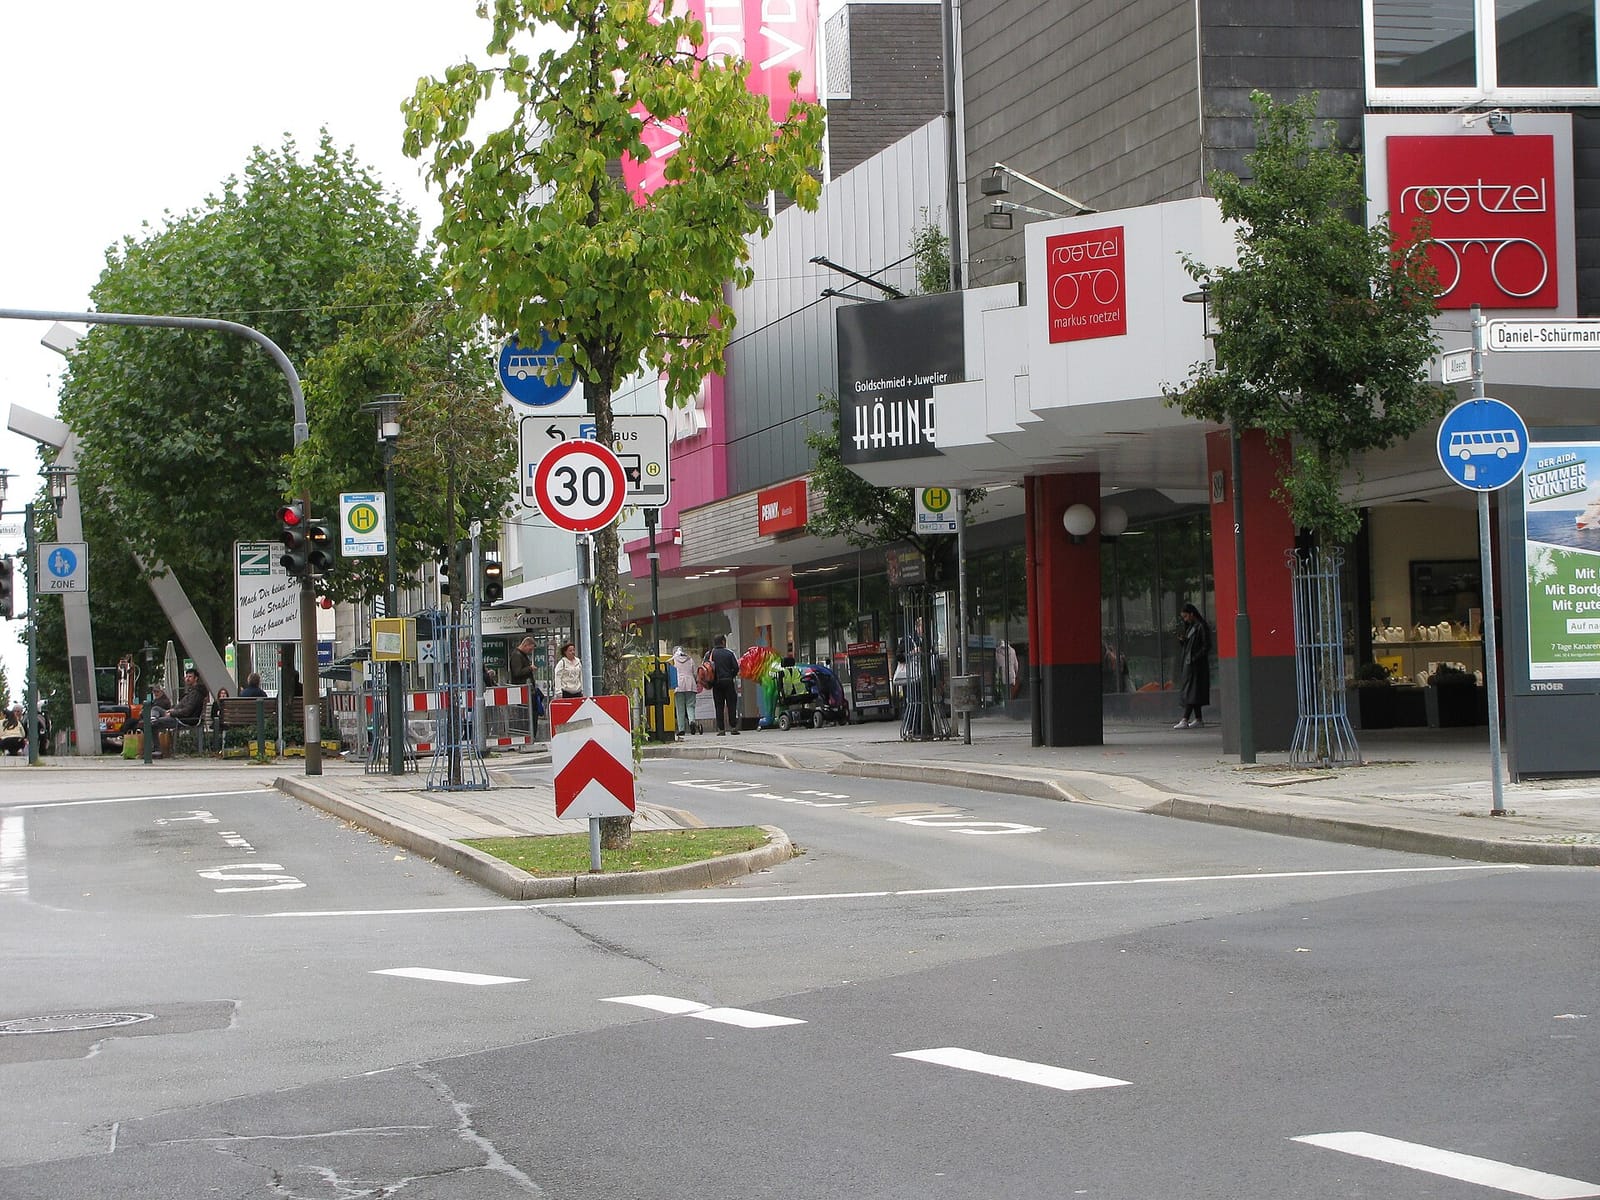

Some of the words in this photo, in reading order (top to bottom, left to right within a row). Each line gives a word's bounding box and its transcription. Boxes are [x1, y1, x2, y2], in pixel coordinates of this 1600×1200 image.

[1400, 178, 1546, 213] roetzel
[1052, 236, 1118, 265] roetzel
[1054, 314, 1087, 328] markus
[1089, 308, 1120, 323] roetzel
[855, 376, 906, 392] Goldschmied
[906, 377, 913, 386] +
[913, 371, 947, 386] Juwelier
[614, 432, 638, 441] BUS
[1538, 458, 1555, 469] DER
[1556, 452, 1577, 464] AIDA
[1529, 463, 1586, 487] SOMMER
[554, 466, 606, 506] 30
[1529, 476, 1586, 500] WINTER
[1234, 523, 1240, 534] 2
[1576, 568, 1596, 579] Mit
[51, 581, 75, 589] ZONE
[1545, 585, 1565, 595] Mit
[240, 593, 257, 607] Mach
[258, 588, 270, 600] Dir
[272, 583, 286, 595] keine
[1553, 600, 1572, 611] Mit
[253, 607, 266, 619] liebe
[522, 616, 551, 624] HOTEL
[1571, 622, 1586, 630] Auf
[251, 624, 266, 639] Jetzt
[1556, 643, 1572, 652] Tage
[1530, 683, 1564, 691] STRÖER
